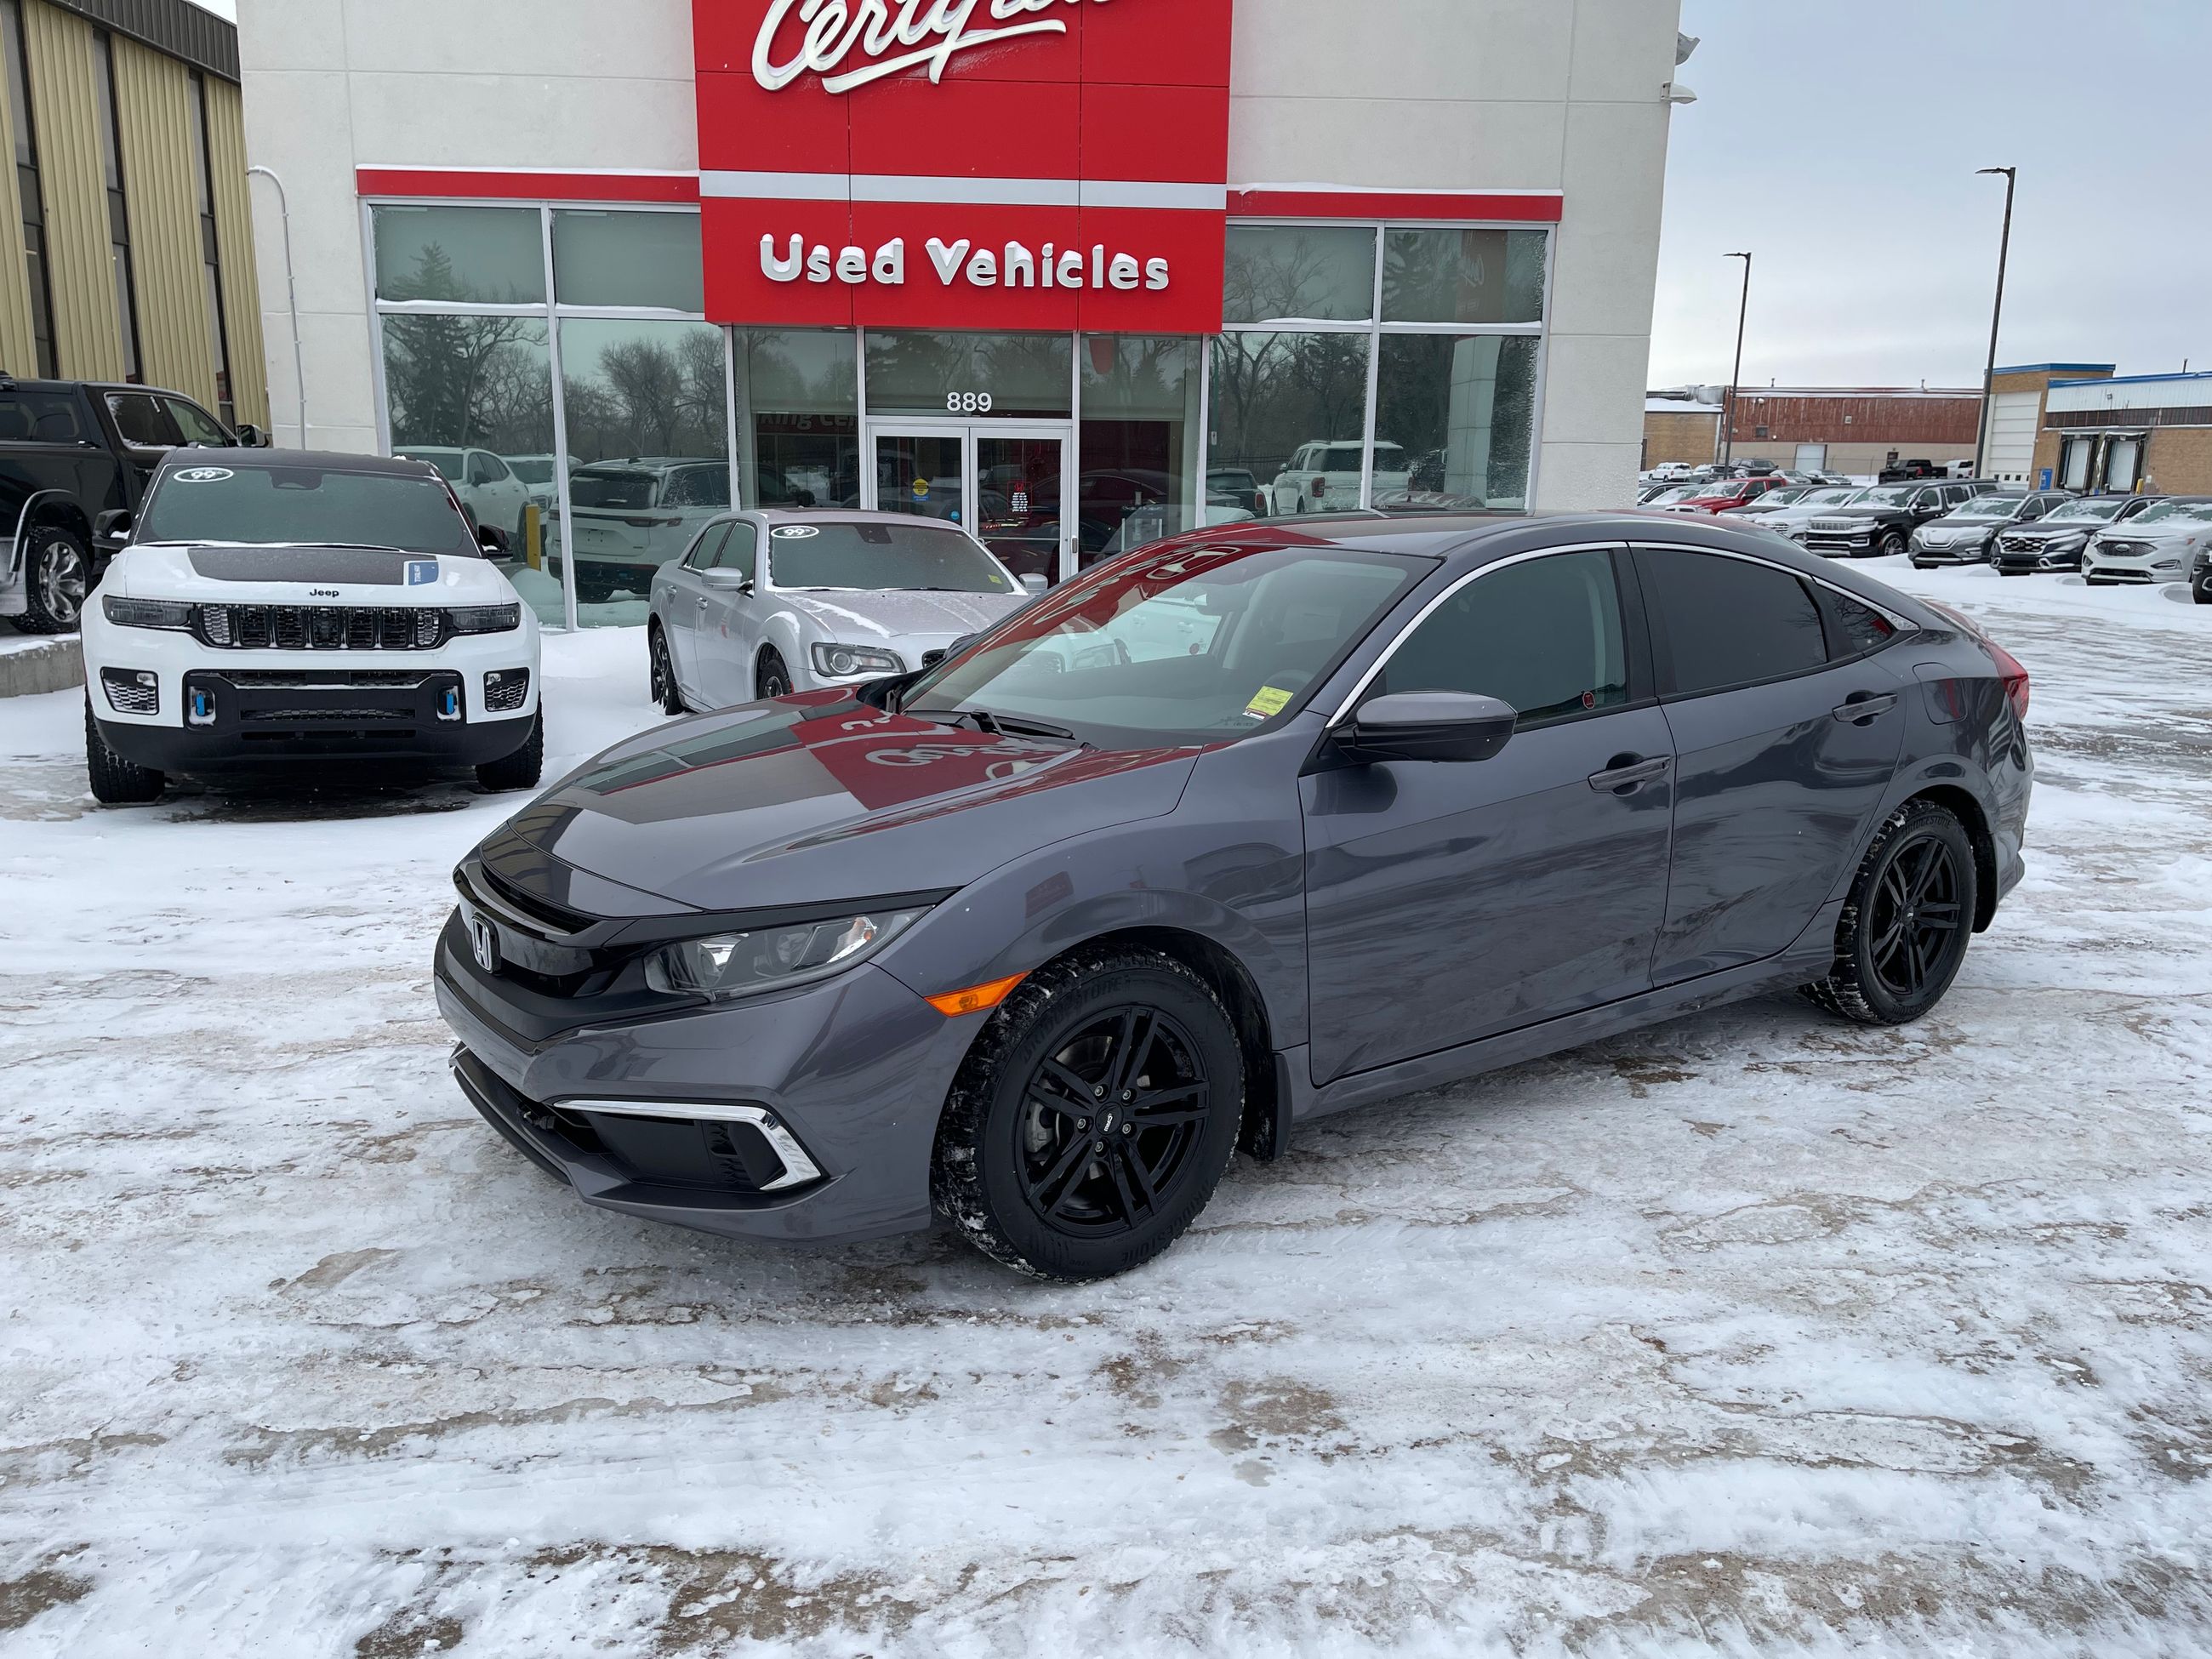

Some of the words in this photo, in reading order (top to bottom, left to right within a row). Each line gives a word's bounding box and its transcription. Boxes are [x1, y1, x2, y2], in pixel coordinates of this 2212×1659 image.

[760, 234, 904, 285] Used
[925, 237, 1170, 291] Vehicles
[947, 391, 992, 413] 889
[309, 588, 339, 598] Jeep
